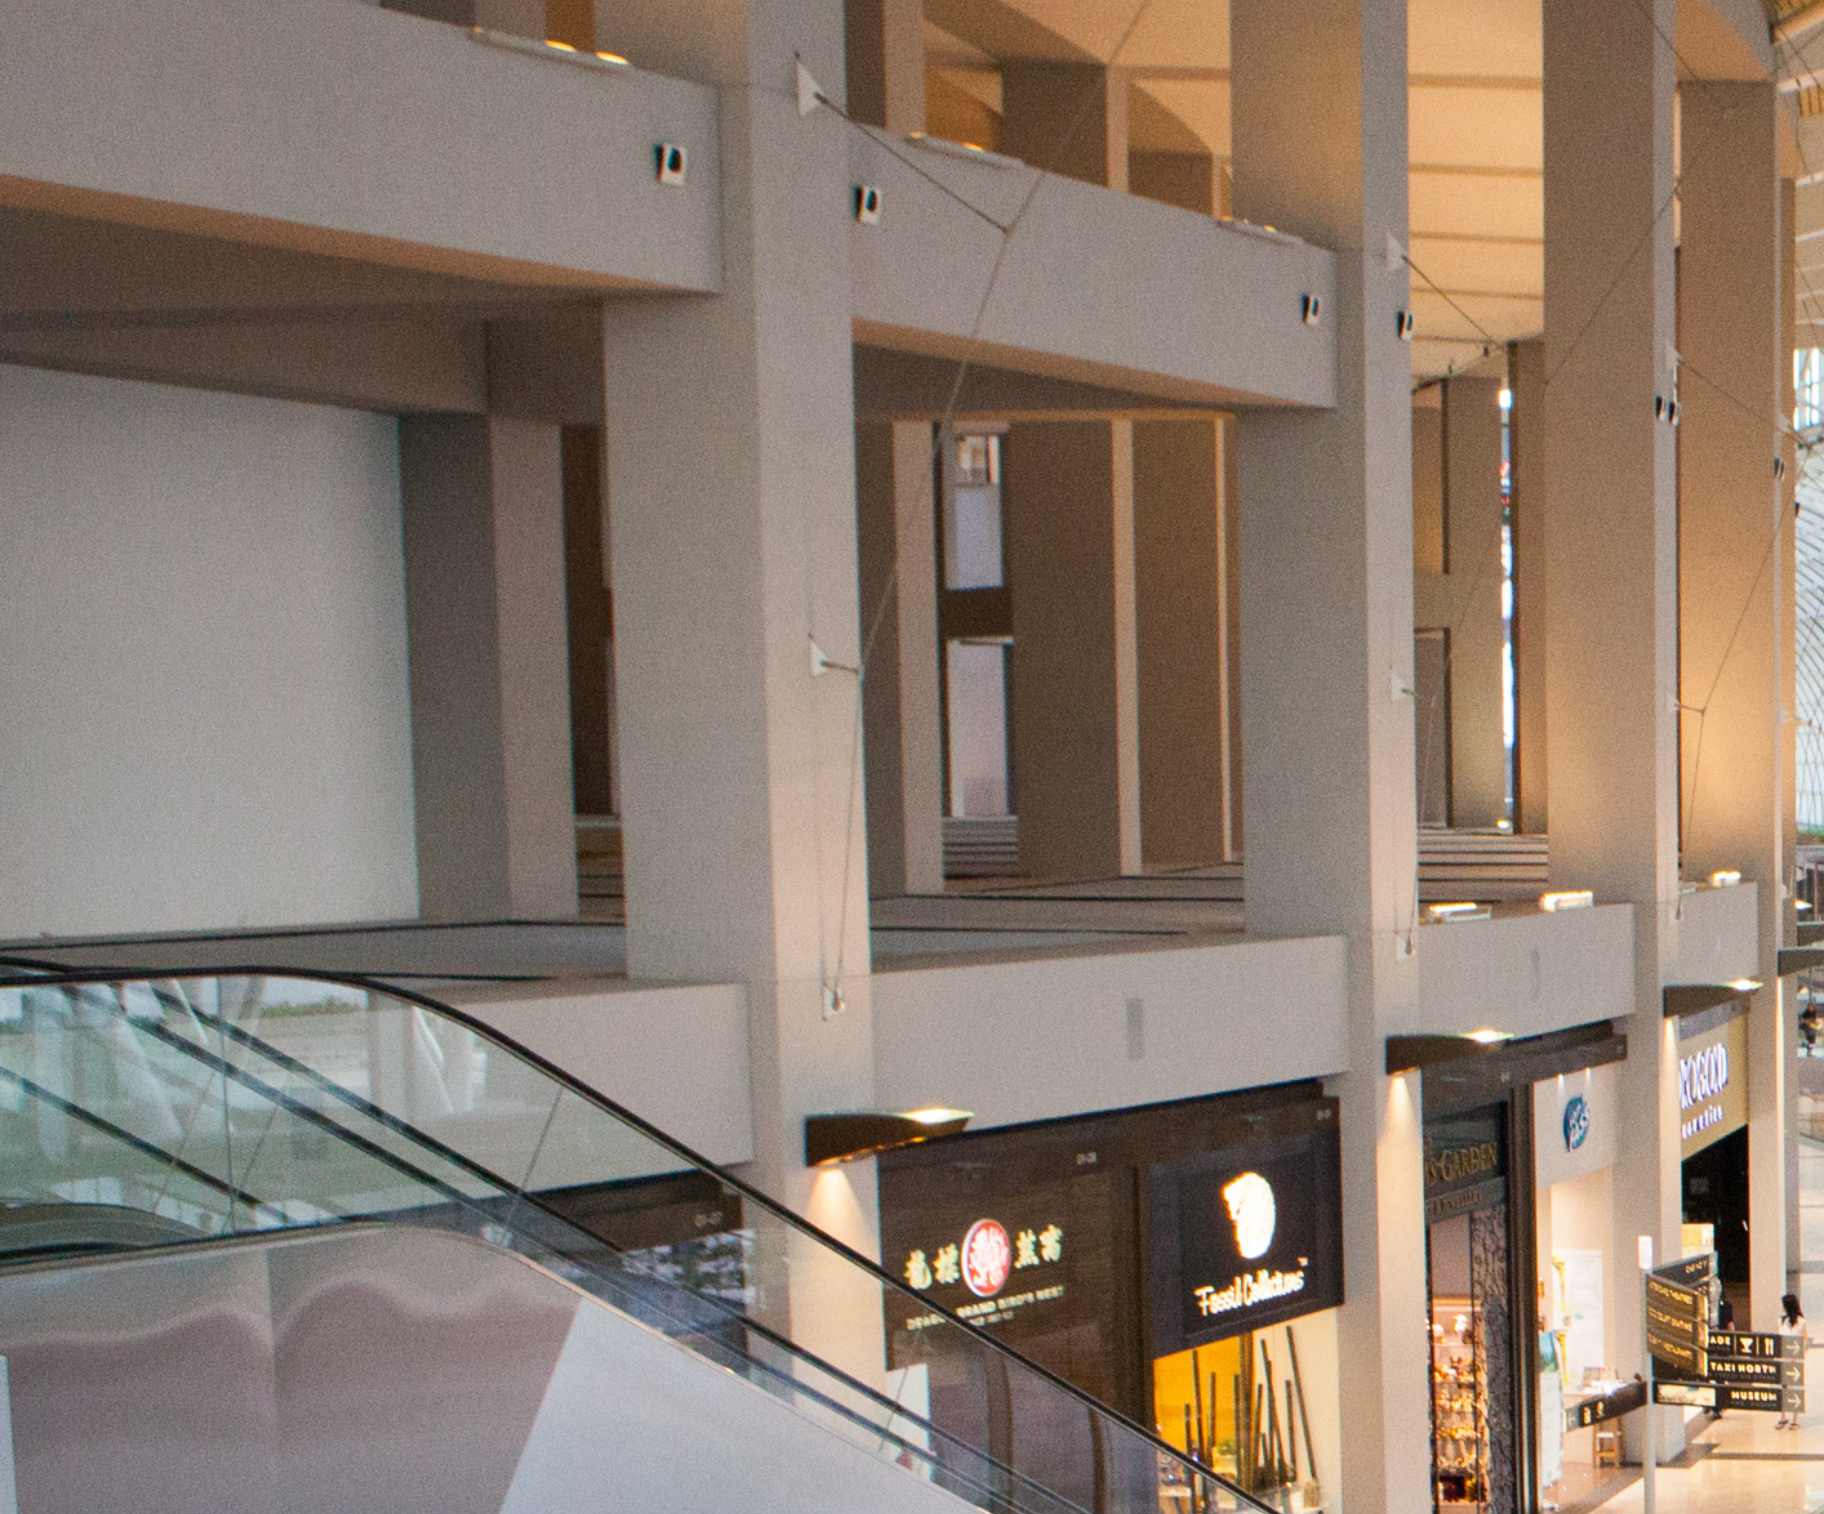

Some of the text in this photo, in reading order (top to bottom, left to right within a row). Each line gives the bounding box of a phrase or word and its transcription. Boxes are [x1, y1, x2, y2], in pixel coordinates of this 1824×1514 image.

[1710, 1362, 1777, 1374] TAXI NORTH
[1731, 1391, 1777, 1401] MUSEUM
